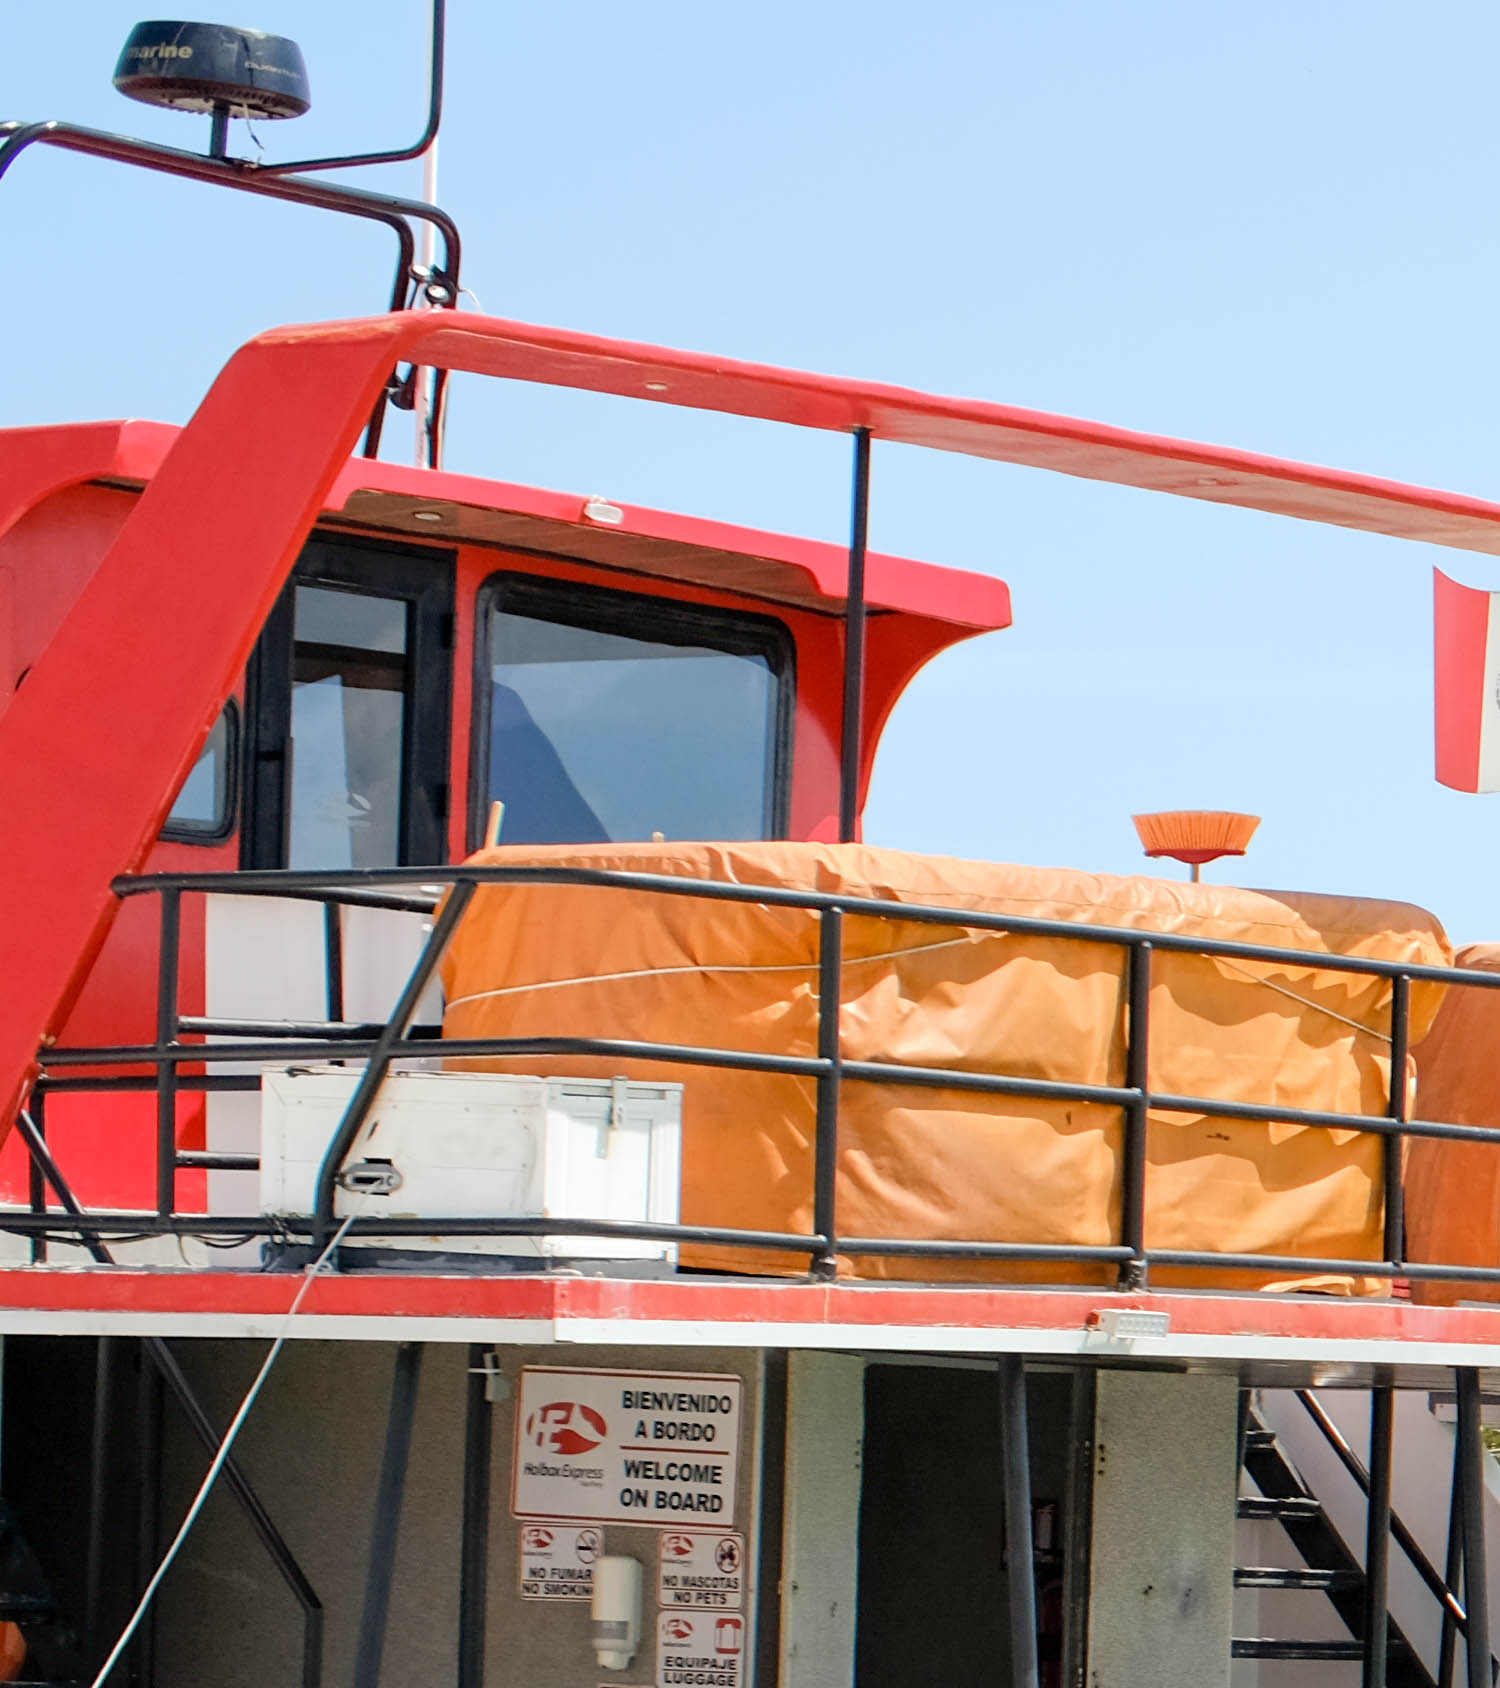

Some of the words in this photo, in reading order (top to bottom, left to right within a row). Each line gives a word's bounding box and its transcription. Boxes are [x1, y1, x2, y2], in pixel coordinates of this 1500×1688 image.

[622, 1390, 732, 1414] BIENVENIDO
[634, 1419, 648, 1439] A
[653, 1420, 716, 1442] BORDO
[623, 1459, 723, 1484] WELCOME
[619, 1487, 649, 1508] ON
[654, 1490, 723, 1513] BOARD
[528, 1567, 546, 1579] NO
[550, 1567, 592, 1580] FUMAR
[522, 1583, 540, 1595] NO
[544, 1583, 593, 1596] SMOKIN
[664, 1575, 679, 1587] NO
[681, 1575, 739, 1590] MASCOTAS
[673, 1591, 692, 1603] NO
[696, 1592, 727, 1605] PETS
[664, 1655, 737, 1671] EQUIPAJE
[664, 1671, 737, 1688] LUGGAGE
